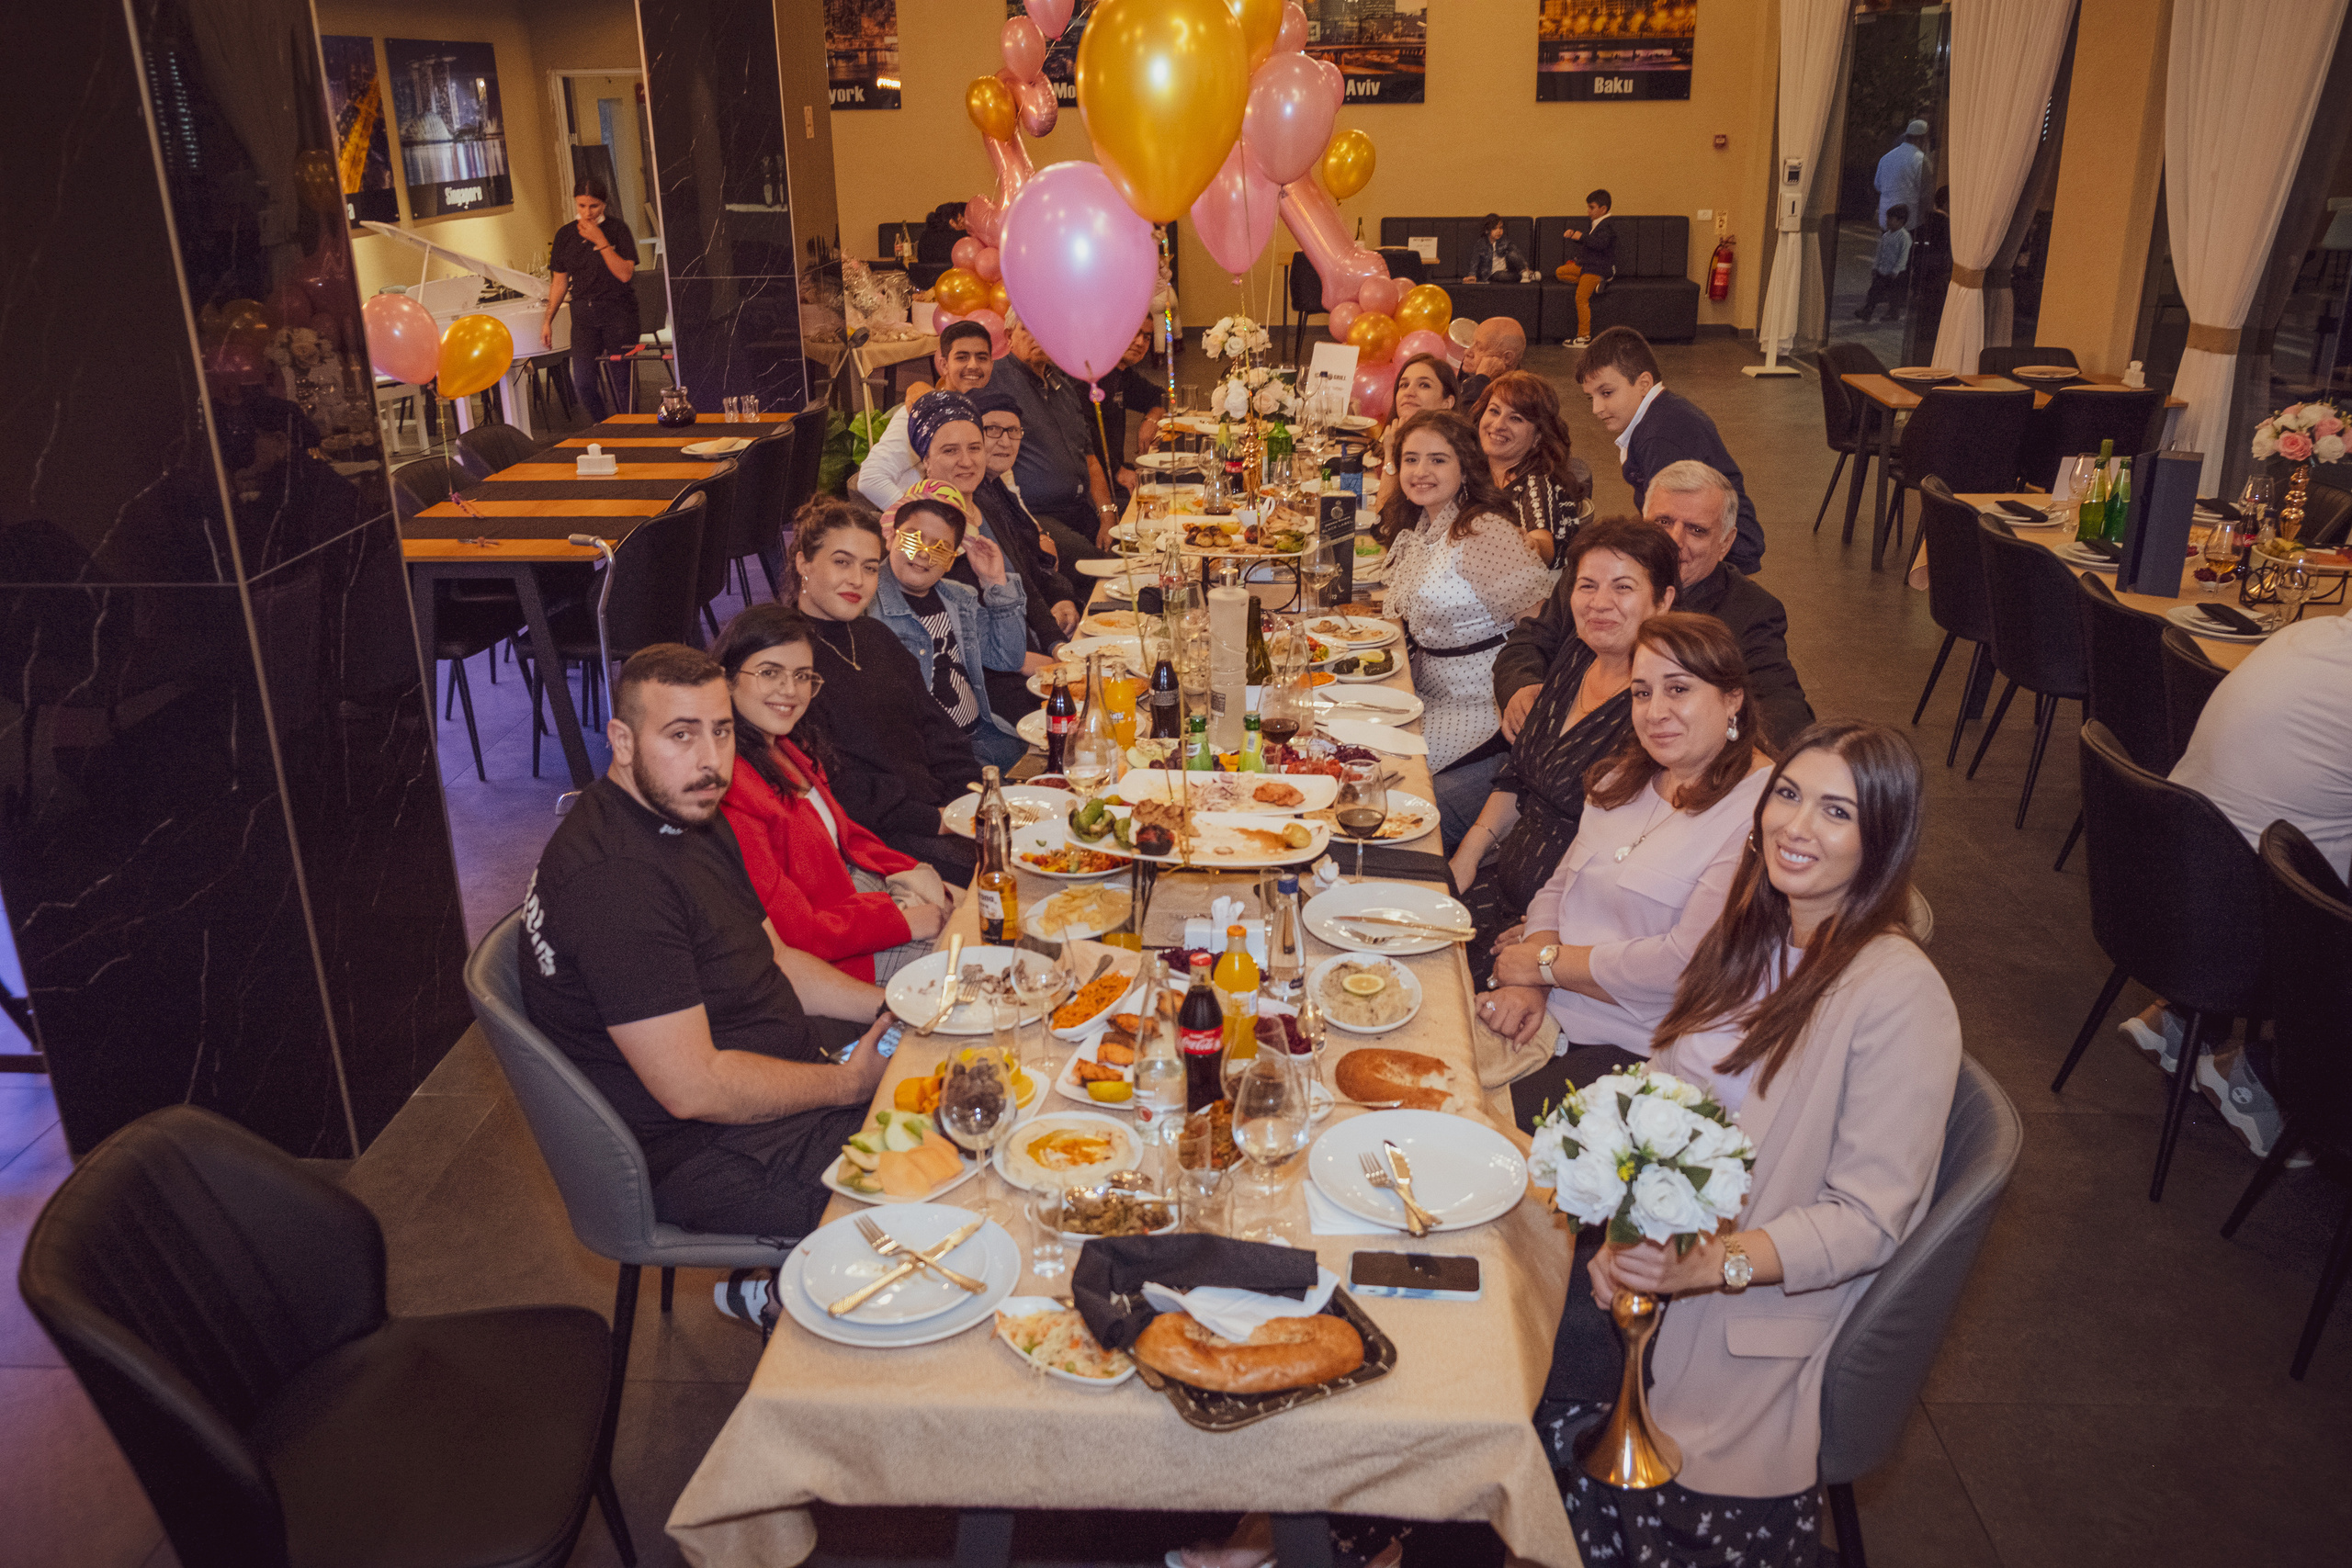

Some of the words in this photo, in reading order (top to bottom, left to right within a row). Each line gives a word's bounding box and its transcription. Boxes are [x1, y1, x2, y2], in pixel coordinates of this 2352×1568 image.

[1346, 79, 1381, 96] Aviv
[1594, 76, 1634, 94] Baku
[829, 85, 865, 105] york
[445, 186, 483, 208] Singapore
